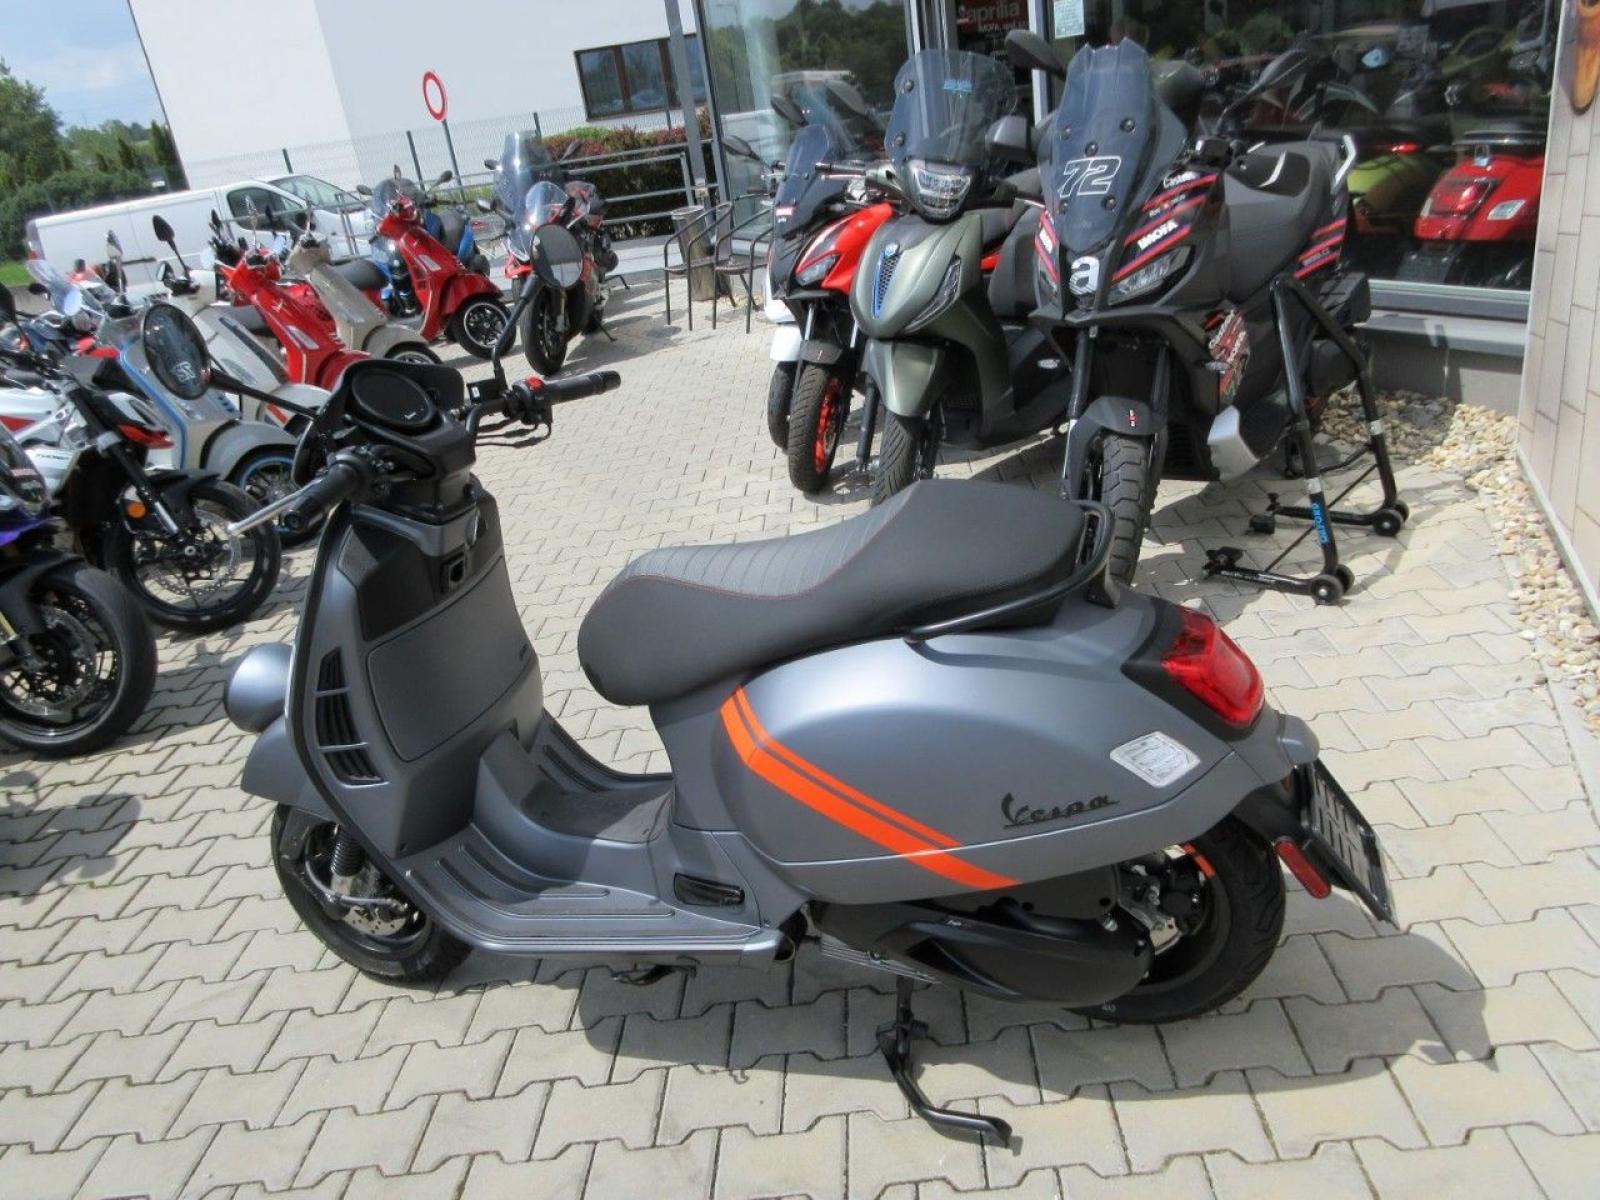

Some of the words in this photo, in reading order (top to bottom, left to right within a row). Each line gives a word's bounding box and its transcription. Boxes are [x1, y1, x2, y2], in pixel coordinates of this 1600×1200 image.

[1058, 155, 1121, 198] 72
[1069, 256, 1100, 294] a
[1001, 792, 1119, 828] Vespa
